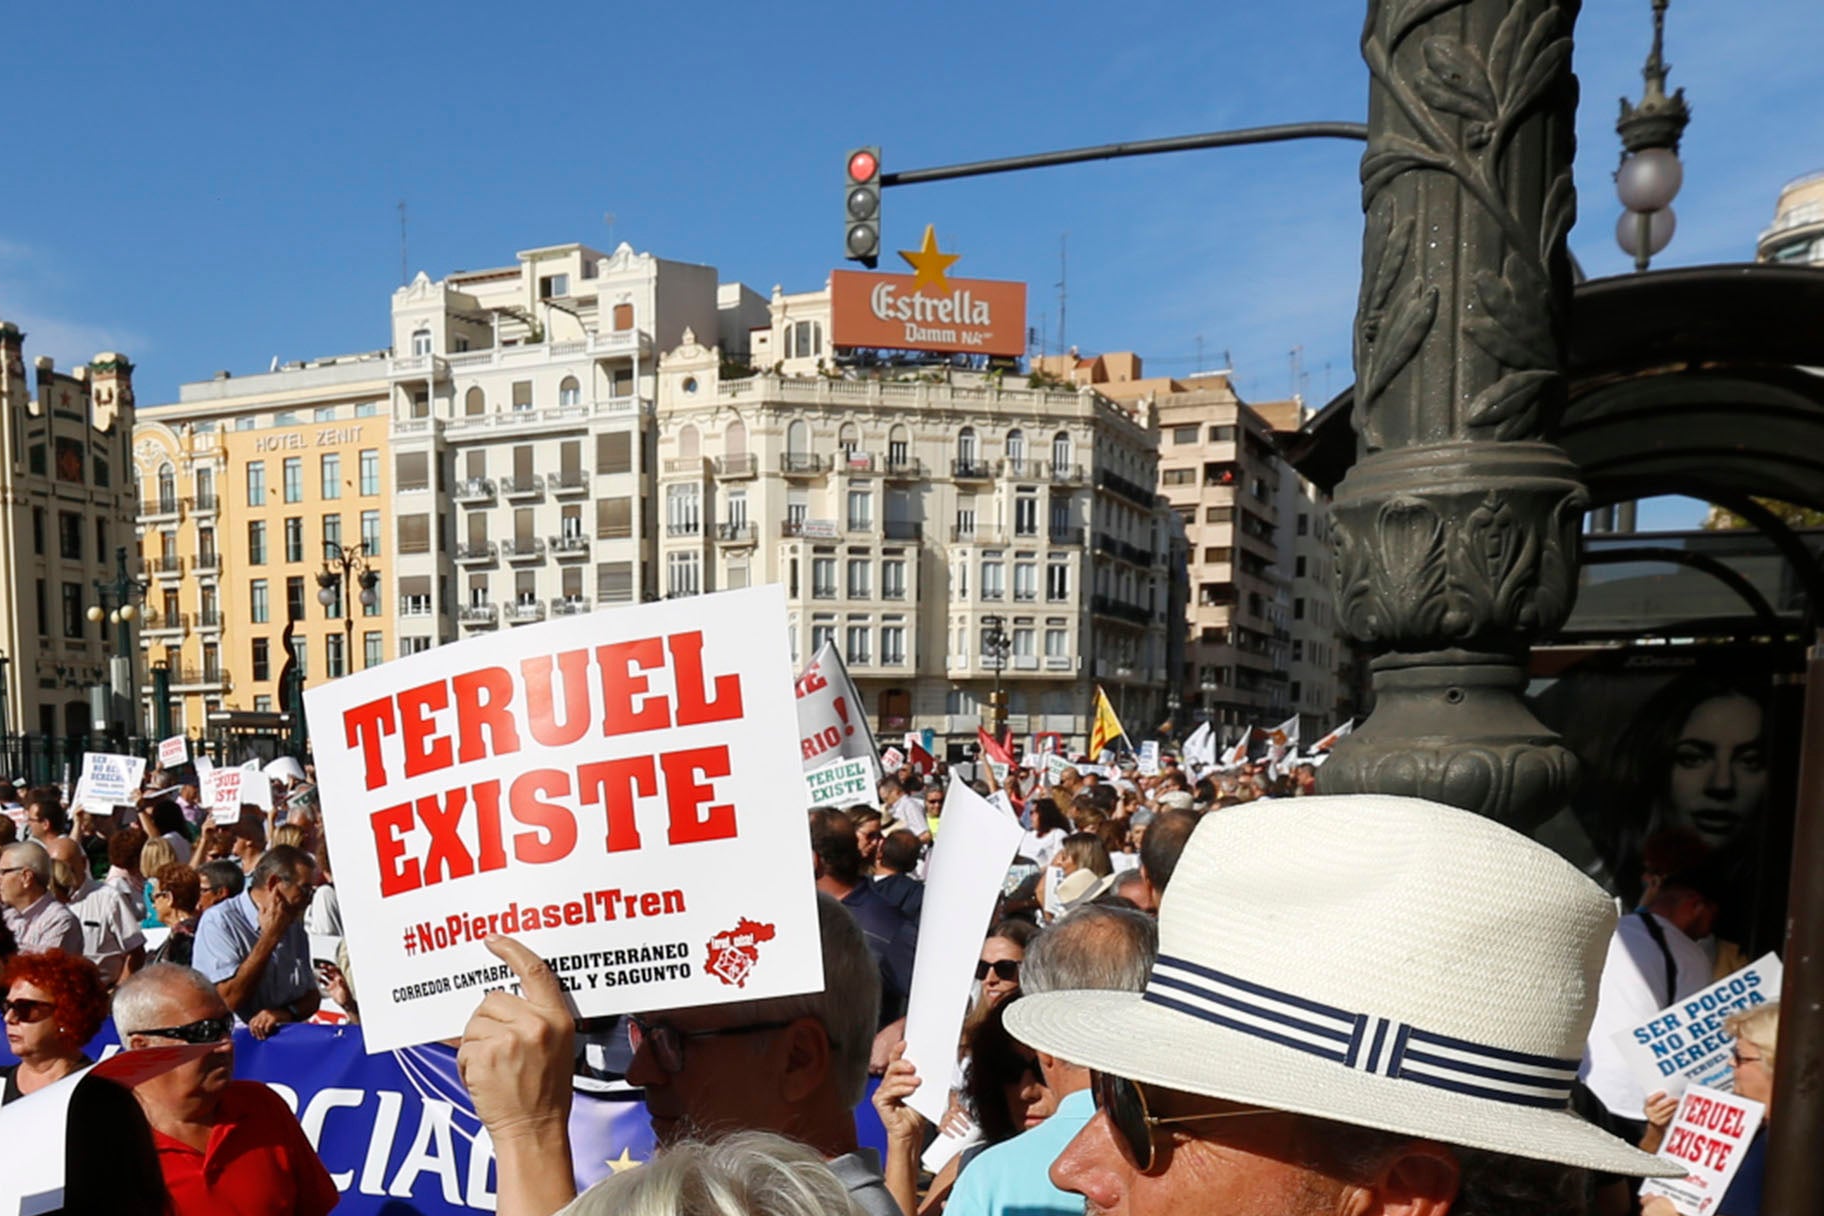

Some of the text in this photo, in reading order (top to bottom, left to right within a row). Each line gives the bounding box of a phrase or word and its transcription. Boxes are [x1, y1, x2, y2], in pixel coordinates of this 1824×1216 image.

[870, 281, 991, 326] Estrella
[904, 323, 957, 343] Damm
[256, 426, 363, 453] HOTEL ZENIT
[342, 630, 744, 792] TERUEL
[806, 762, 866, 788] TERUEL
[812, 777, 867, 803] EXISTE
[369, 744, 738, 899] EXISTE
[403, 888, 687, 957] #NoPierdaselTren
[392, 977, 452, 1003] CORREDOR
[587, 974, 598, 989] Y
[604, 962, 691, 988] SAGUNTO
[1633, 970, 1762, 1044] SER POCOS
[1650, 1033, 1685, 1058] NO
[1657, 1029, 1734, 1077] DEREC
[1679, 1093, 1746, 1140] TERUEL
[1665, 1126, 1733, 1173] EXISTE
